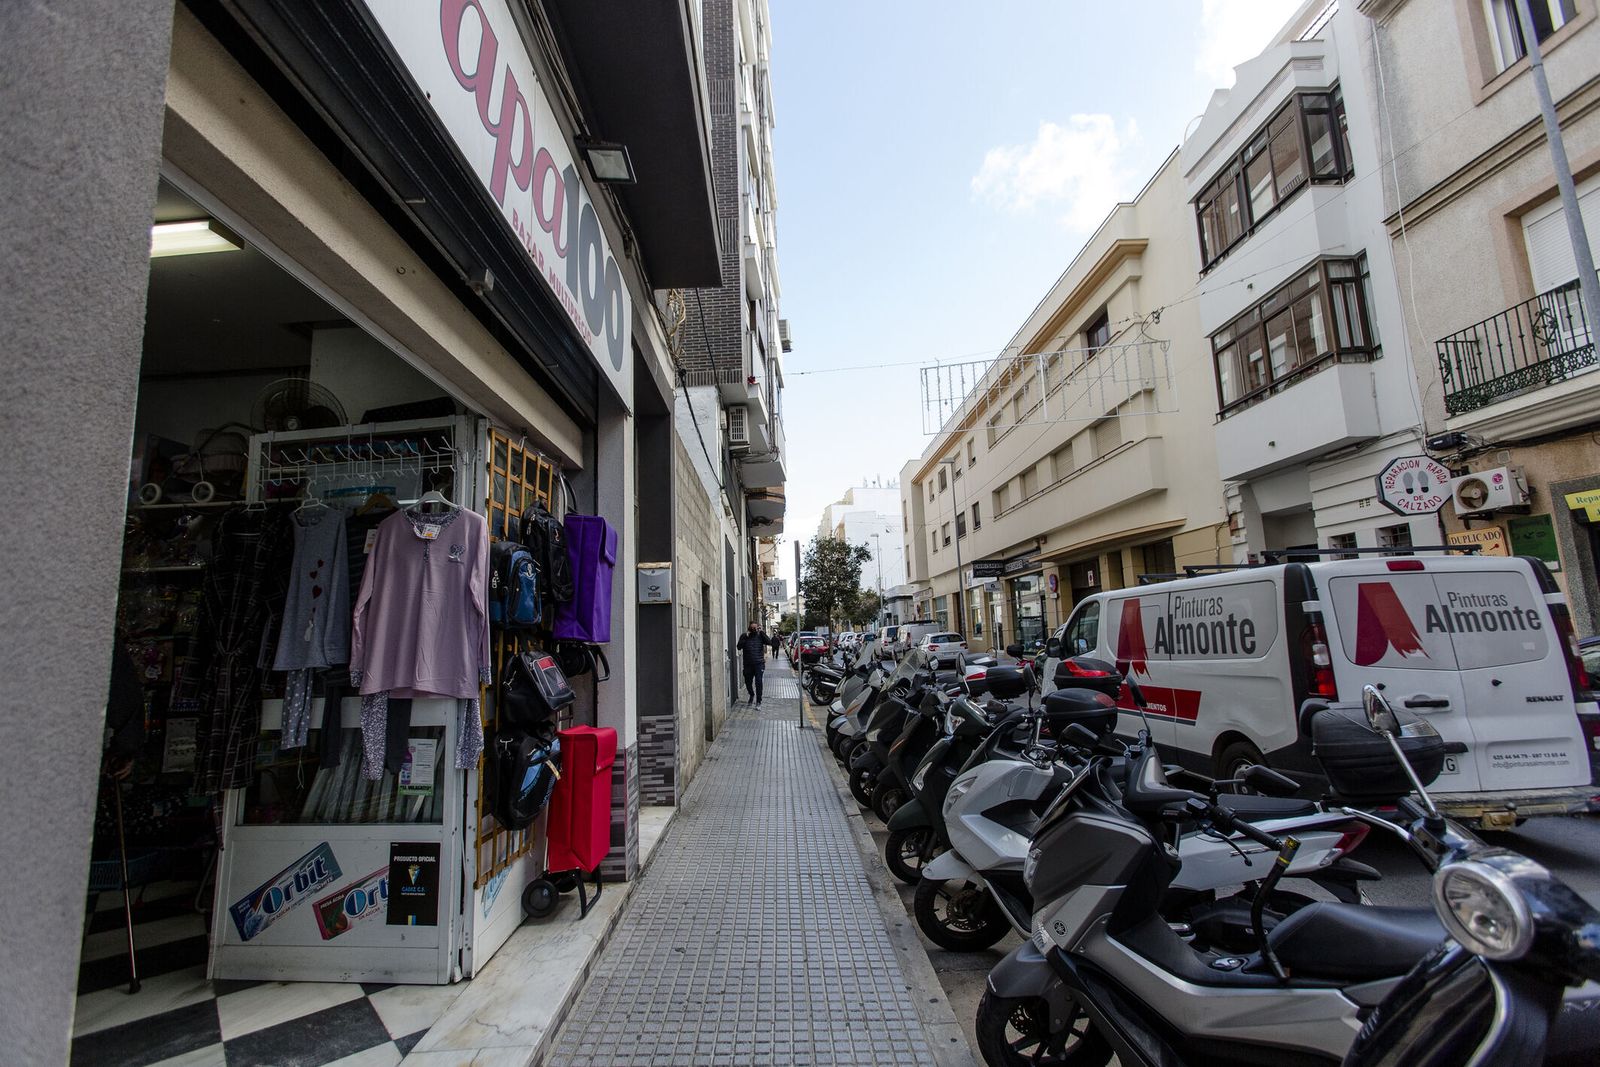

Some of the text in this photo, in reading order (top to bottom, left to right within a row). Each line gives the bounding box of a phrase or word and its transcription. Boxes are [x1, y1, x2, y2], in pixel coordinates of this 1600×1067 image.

[513, 208, 592, 346] BAZAR MULTIPRECIO
[1385, 460, 1448, 489] REPARACION RAPIDA
[1398, 496, 1442, 511] CALZADO
[1450, 530, 1501, 545] DUPLICADO
[1175, 596, 1223, 619] Pinturas
[1447, 592, 1508, 608] Pinturas
[1425, 604, 1542, 633] Almonte
[1155, 613, 1257, 655] Almonte
[1525, 694, 1564, 702] RENAULT
[261, 855, 329, 914] Orbit
